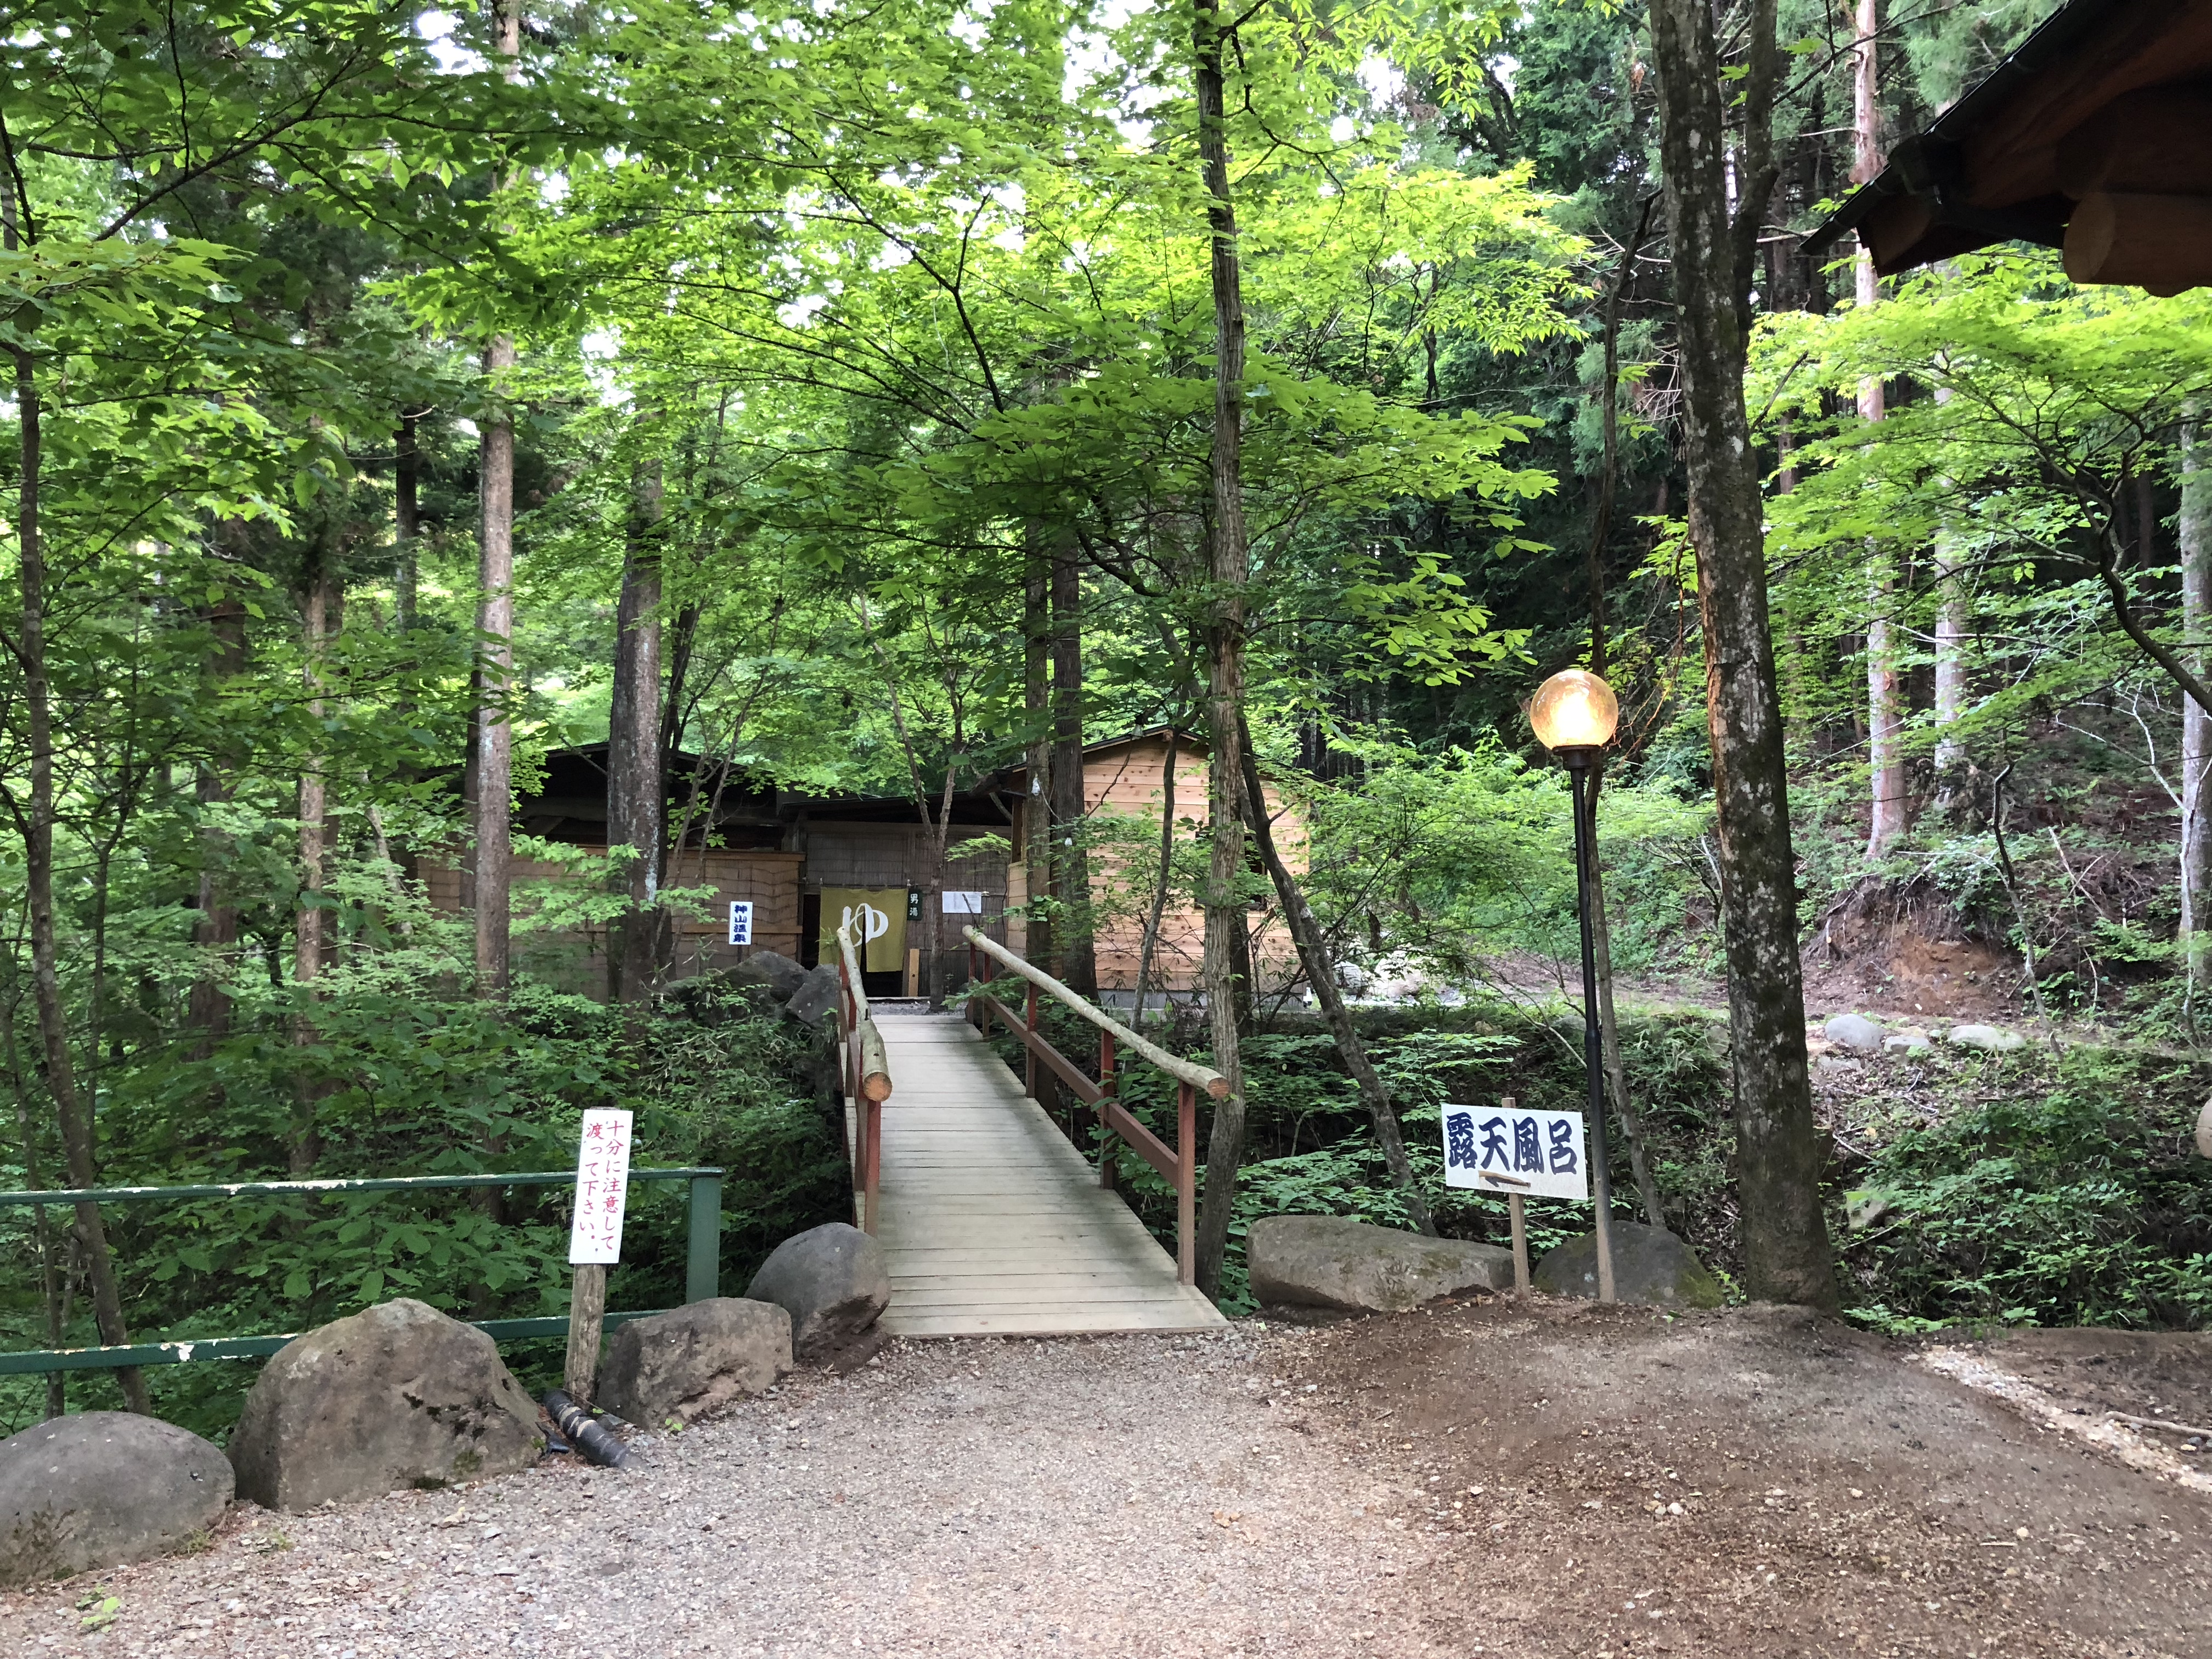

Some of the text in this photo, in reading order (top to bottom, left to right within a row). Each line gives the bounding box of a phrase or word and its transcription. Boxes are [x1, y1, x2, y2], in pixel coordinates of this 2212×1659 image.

[842, 903, 889, 947] ゆ
[1446, 1111, 1578, 1176] 露天風呂
[600, 1120, 625, 1250] 十分に注意して
